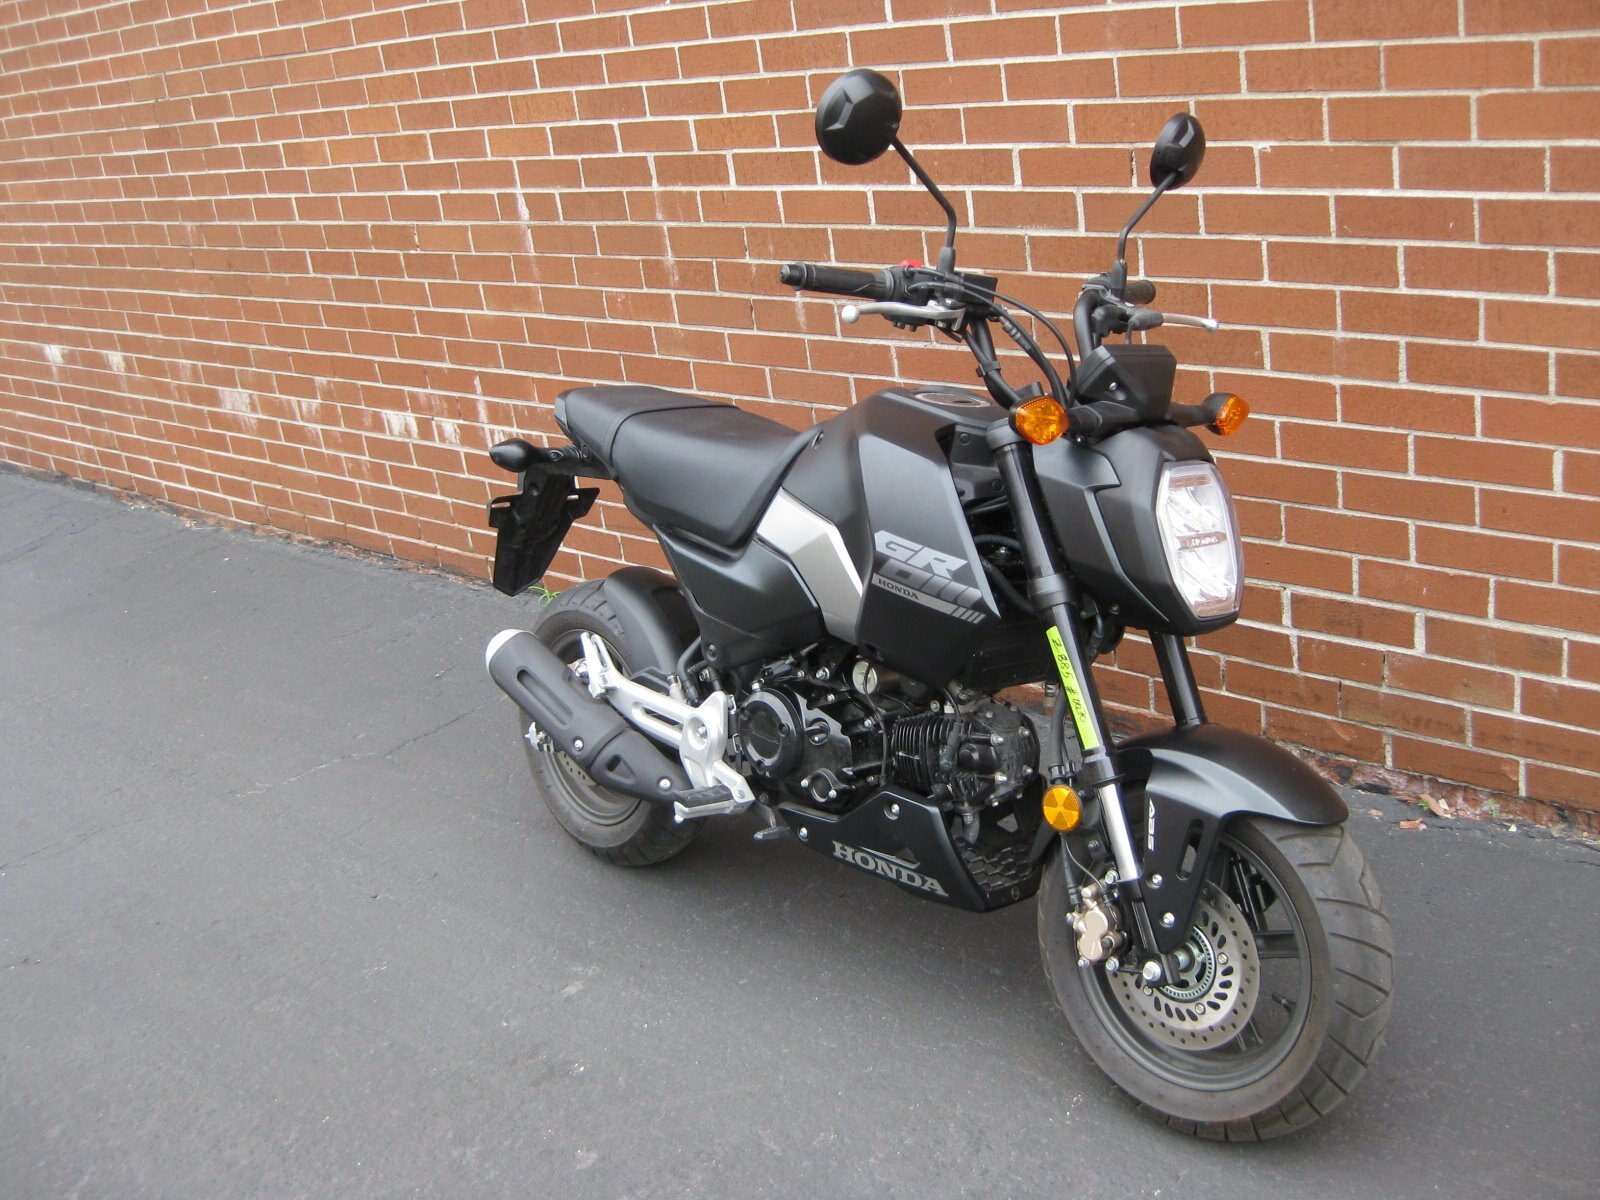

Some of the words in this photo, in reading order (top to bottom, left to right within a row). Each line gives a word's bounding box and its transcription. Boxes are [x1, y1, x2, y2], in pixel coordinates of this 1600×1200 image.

[878, 578, 920, 601] HONDA
[1143, 798, 1156, 852] ABS
[832, 840, 949, 898] HONDA
